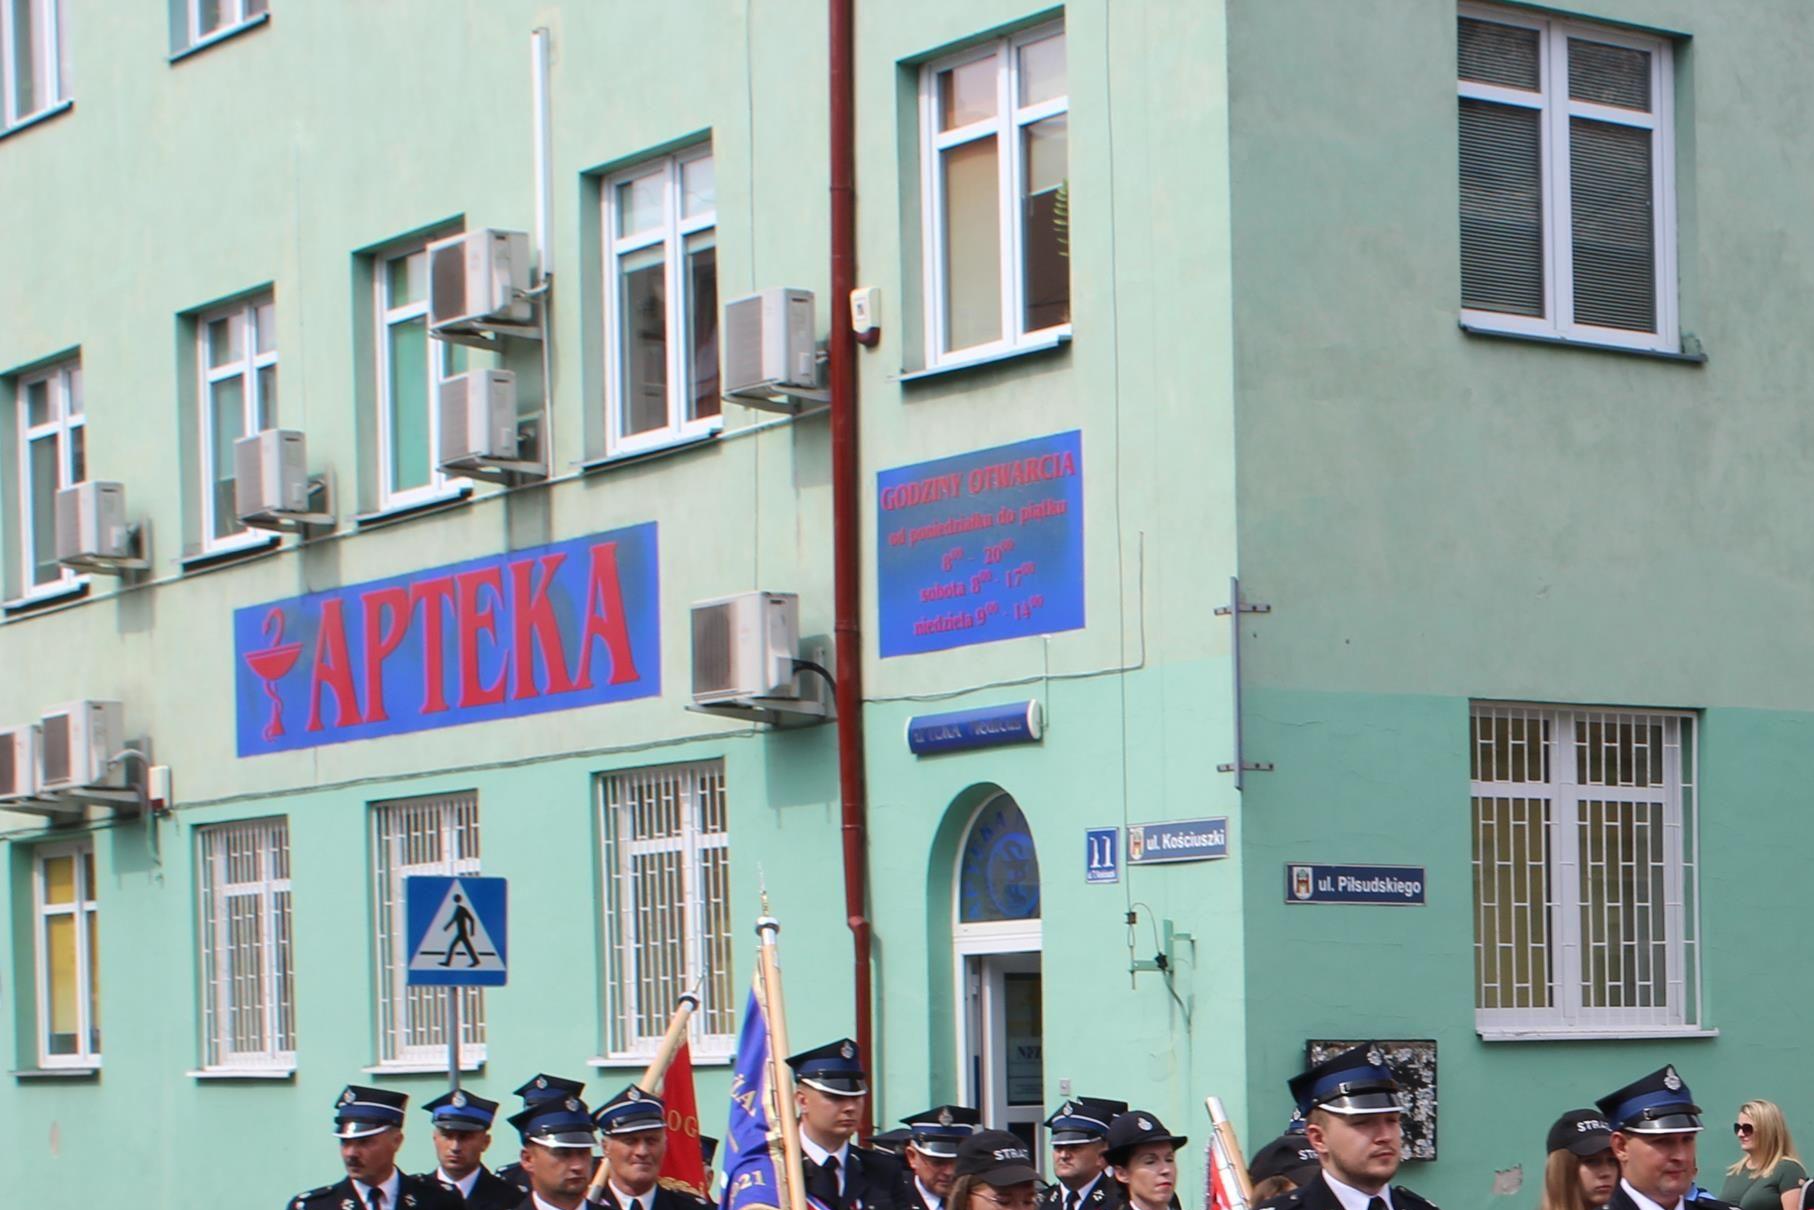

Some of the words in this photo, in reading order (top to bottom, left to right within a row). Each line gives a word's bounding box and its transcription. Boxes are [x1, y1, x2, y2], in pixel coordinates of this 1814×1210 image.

[882, 473, 962, 510] GODZINY
[968, 452, 1076, 494] OTWARCIA
[888, 528, 906, 547] od
[997, 506, 1015, 525] do
[920, 581, 965, 602] sobota
[306, 541, 640, 733] APTEKA
[914, 611, 973, 635] niedziela
[1089, 835, 1114, 868] 11
[1146, 834, 1160, 850] ul.
[1162, 829, 1225, 849] Kościuszki
[1318, 876, 1335, 892] ul.
[1338, 876, 1421, 897] Piłsudskiego
